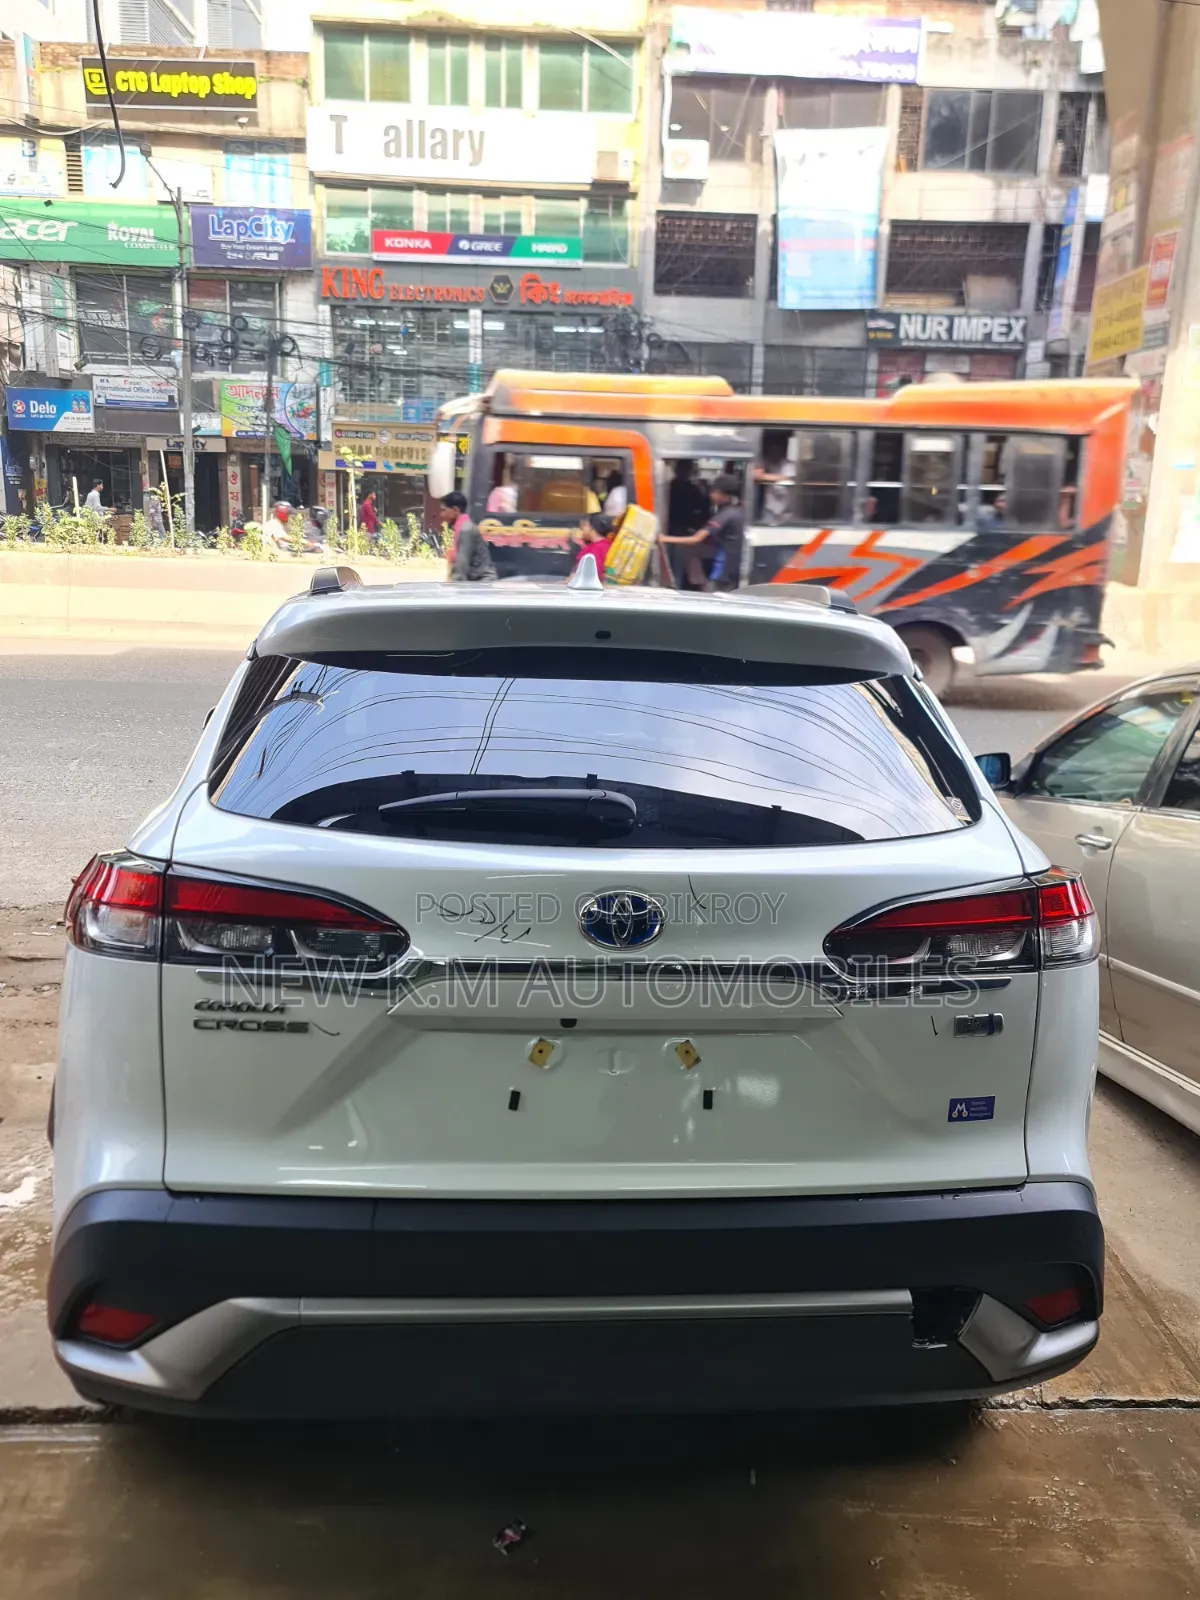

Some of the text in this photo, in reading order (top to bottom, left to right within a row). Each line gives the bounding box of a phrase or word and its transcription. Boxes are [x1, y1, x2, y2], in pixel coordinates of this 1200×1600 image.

[150, 72, 211, 98] Laptop
[212, 72, 257, 100] Shop
[383, 119, 486, 167] allary
[0, 218, 78, 243] acer
[208, 213, 296, 245] LapCity
[384, 237, 433, 250] KONKA
[470, 241, 504, 252] GREE
[320, 265, 485, 303] KING ELECTRONICS
[899, 313, 1027, 343] NUR IMPEX
[95, 384, 132, 393] International
[132, 386, 151, 394] Office
[29, 400, 57, 415] Delo
[166, 437, 208, 451] Lapity
[193, 1018, 310, 1034] CROSS
